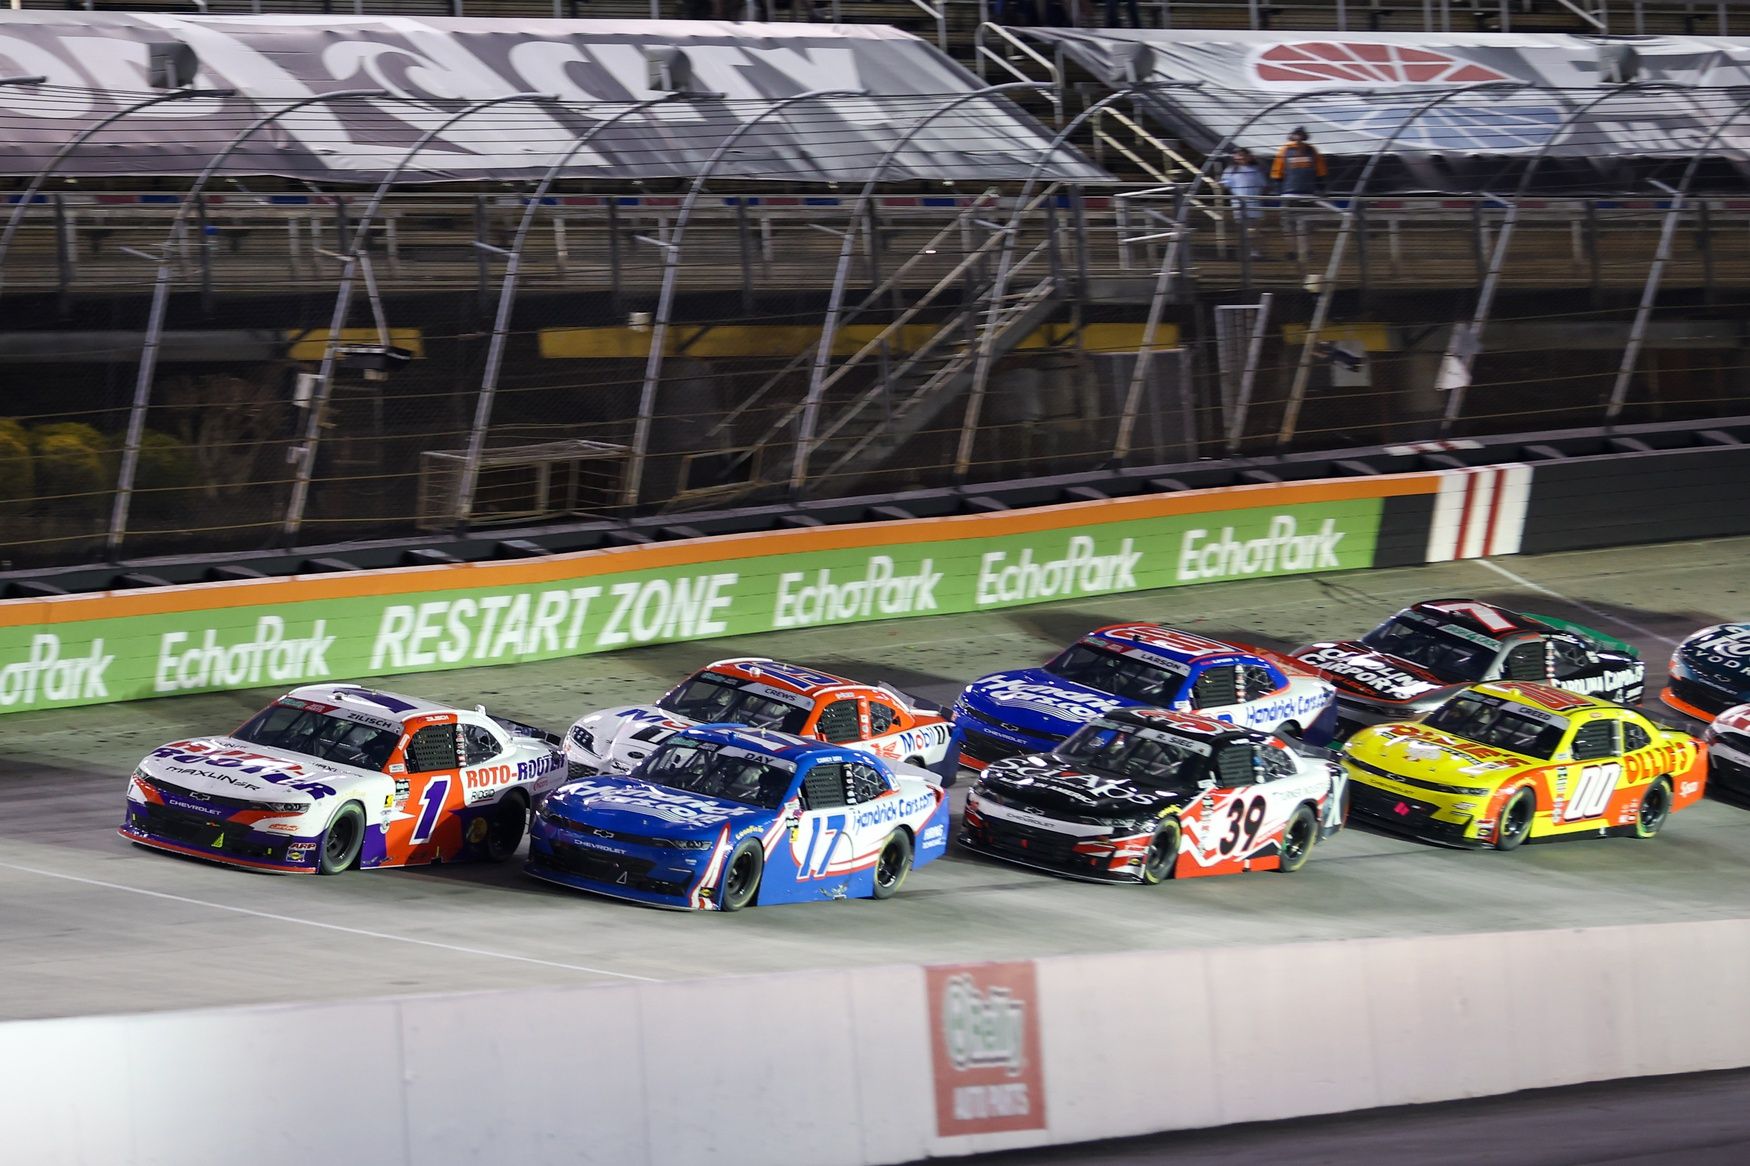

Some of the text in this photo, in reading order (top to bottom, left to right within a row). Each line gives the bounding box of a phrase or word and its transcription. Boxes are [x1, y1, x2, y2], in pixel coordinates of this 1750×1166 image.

[1177, 515, 1345, 580] EchoPark
[974, 535, 1144, 605] EchoPark
[772, 555, 945, 627] EchoPark
[369, 573, 739, 670] RESTART ZONE
[154, 615, 336, 692] EchoPark
[1141, 653, 1182, 670] LARSON
[764, 688, 797, 702] CREWS
[346, 712, 393, 729] ZILISCH
[1519, 706, 1551, 721] CREED
[900, 729, 936, 754] Mobil
[984, 728, 1028, 745] CHEVROLET
[744, 752, 775, 766] DAY
[1564, 762, 1622, 821] 00
[168, 799, 222, 816] CHEVROLET
[409, 775, 452, 845] 1
[1219, 795, 1267, 856] 39
[289, 842, 317, 851] ARP
[573, 838, 627, 855] CHEVROLET
[796, 814, 847, 881] 17
